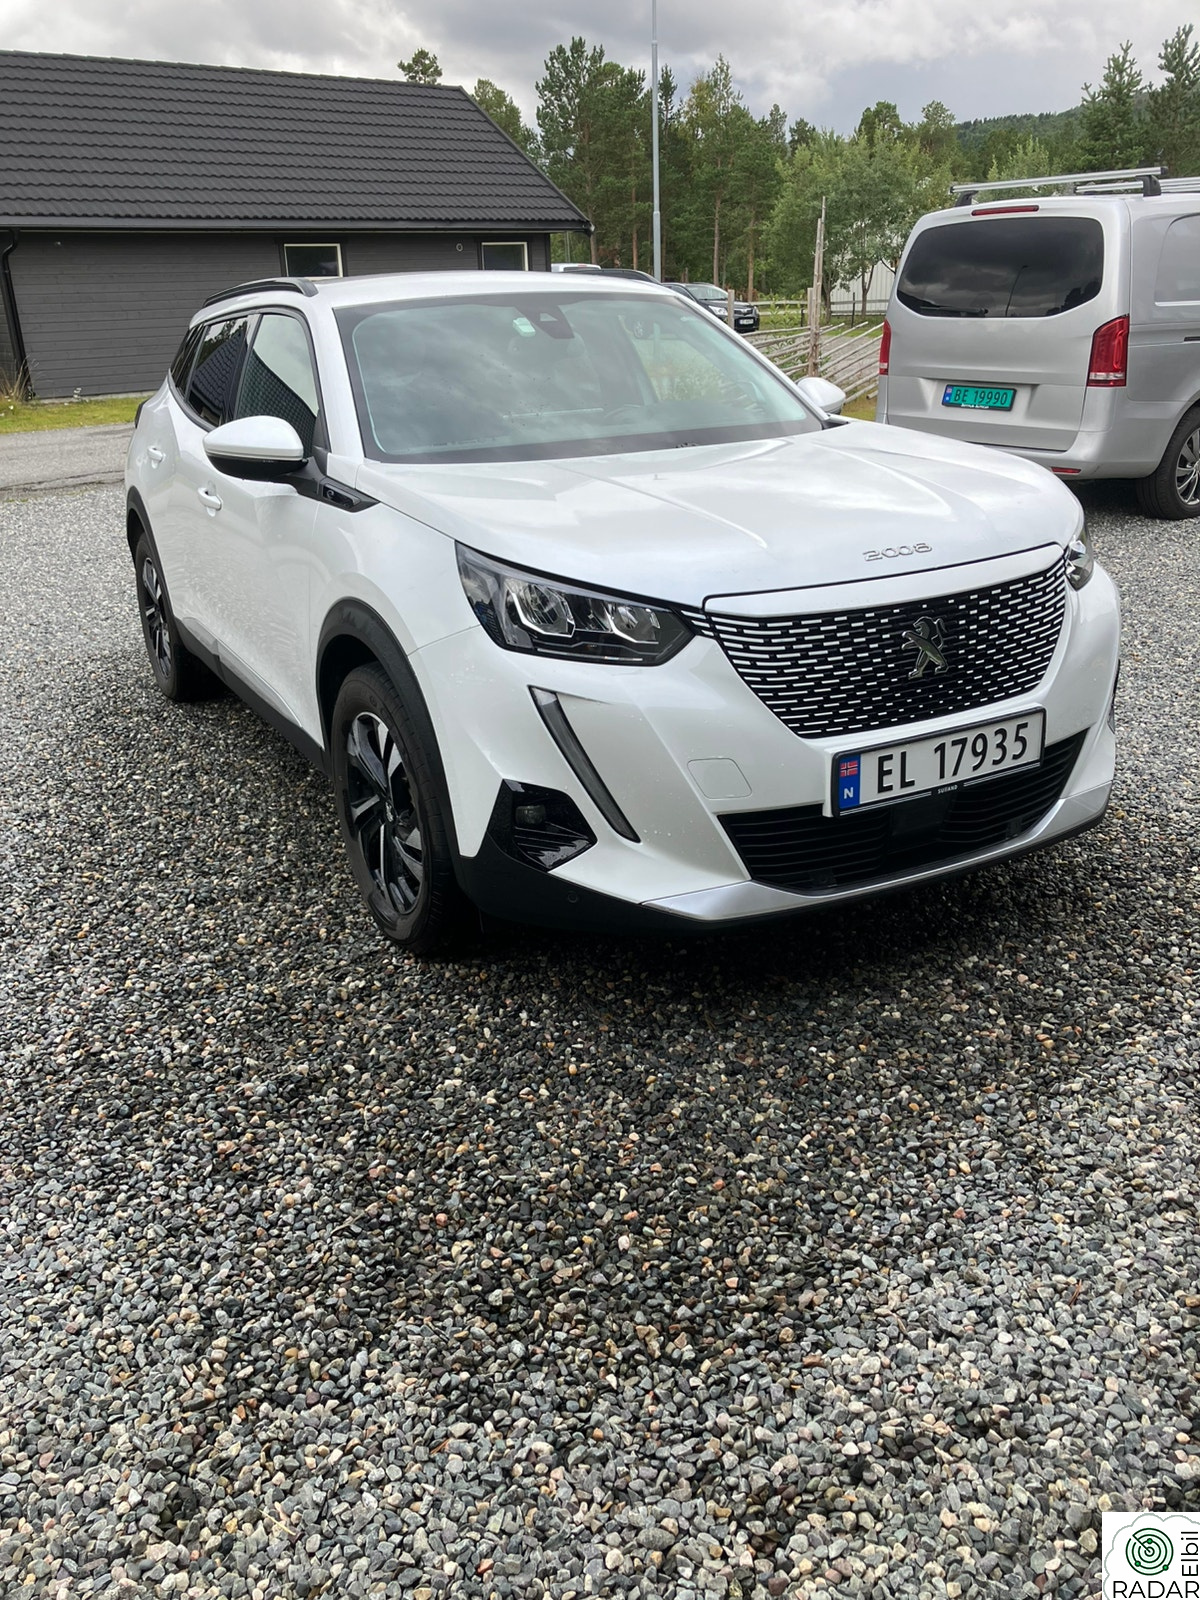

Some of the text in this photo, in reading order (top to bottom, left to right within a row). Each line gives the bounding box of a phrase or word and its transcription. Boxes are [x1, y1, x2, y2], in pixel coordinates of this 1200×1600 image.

[954, 389, 1008, 405] BE 19990
[862, 542, 933, 562] 2008
[877, 722, 1029, 794] EL 17935
[843, 786, 854, 799] N
